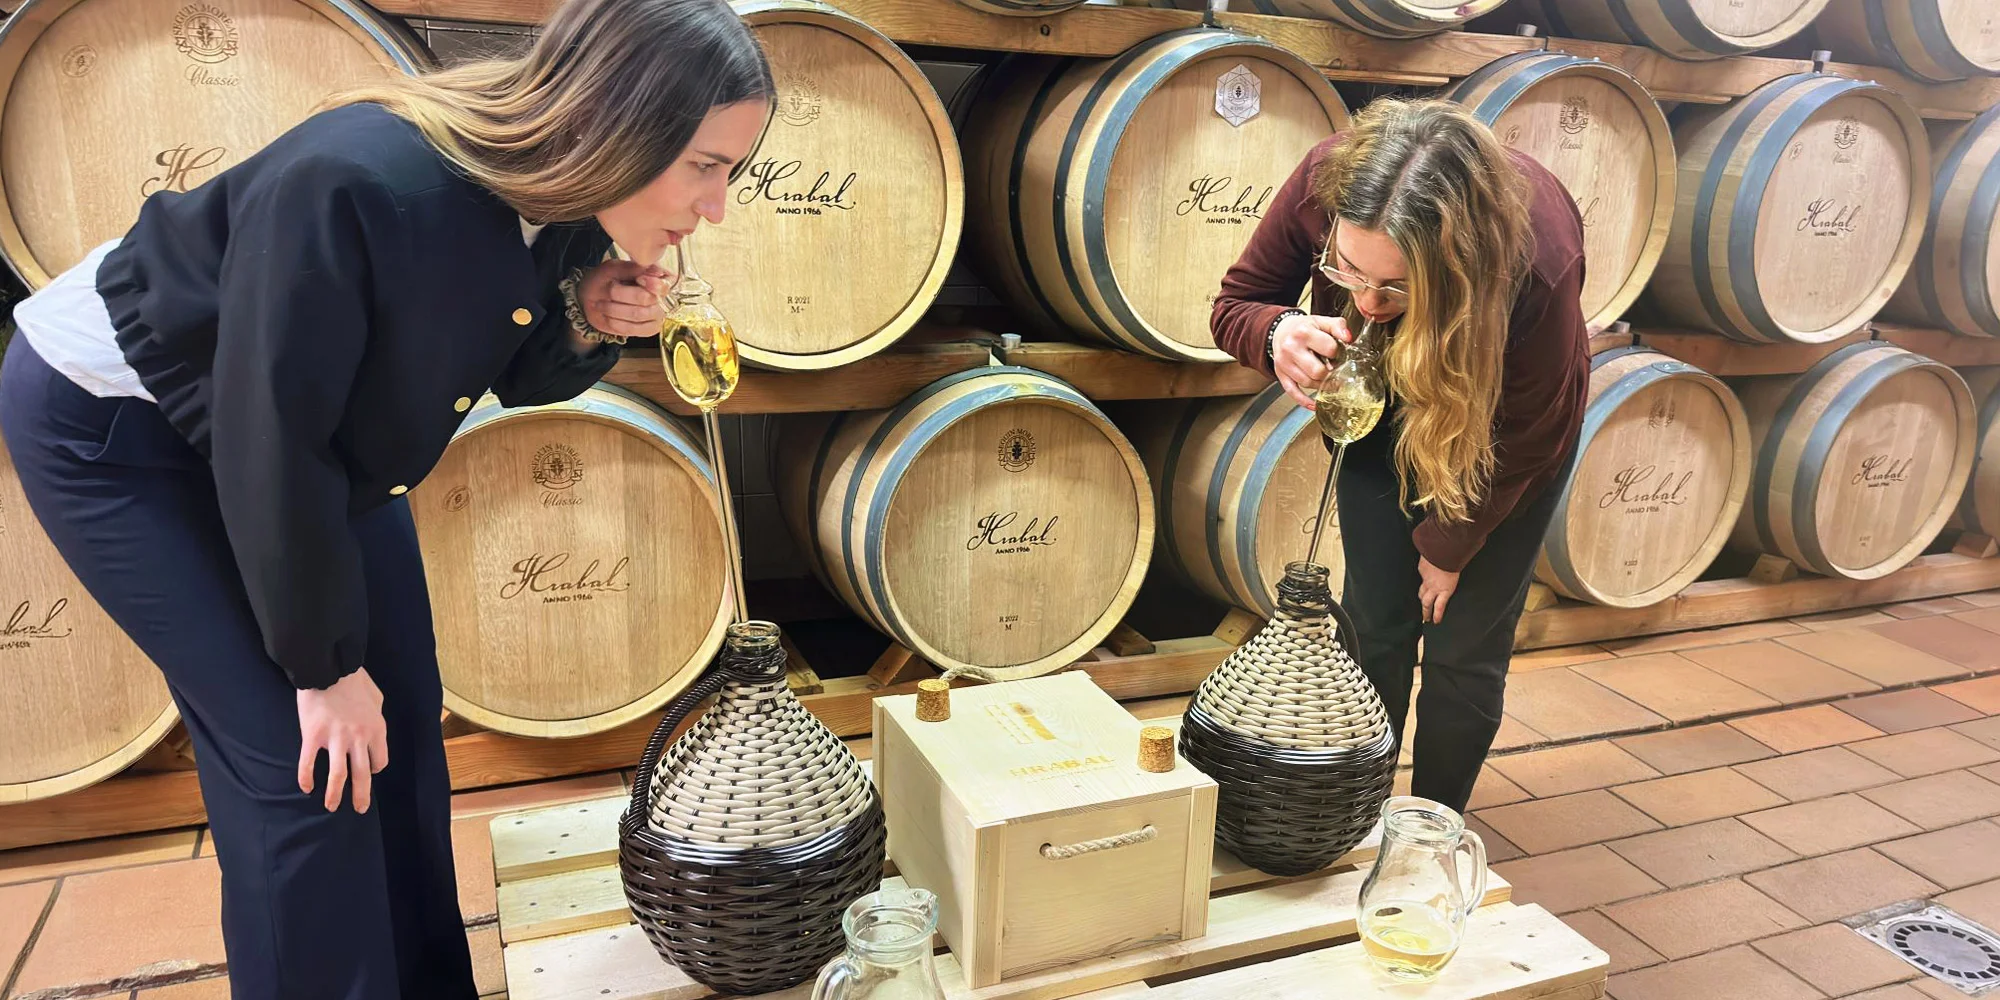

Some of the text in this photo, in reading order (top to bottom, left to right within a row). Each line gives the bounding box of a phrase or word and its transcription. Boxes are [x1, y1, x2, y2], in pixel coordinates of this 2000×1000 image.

[184, 63, 239, 87] Classic
[775, 206, 822, 216] ANNO 1966
[1227, 217, 1242, 225] 1966
[539, 490, 584, 509] Classic
[543, 593, 593, 604] ANNO 1966
